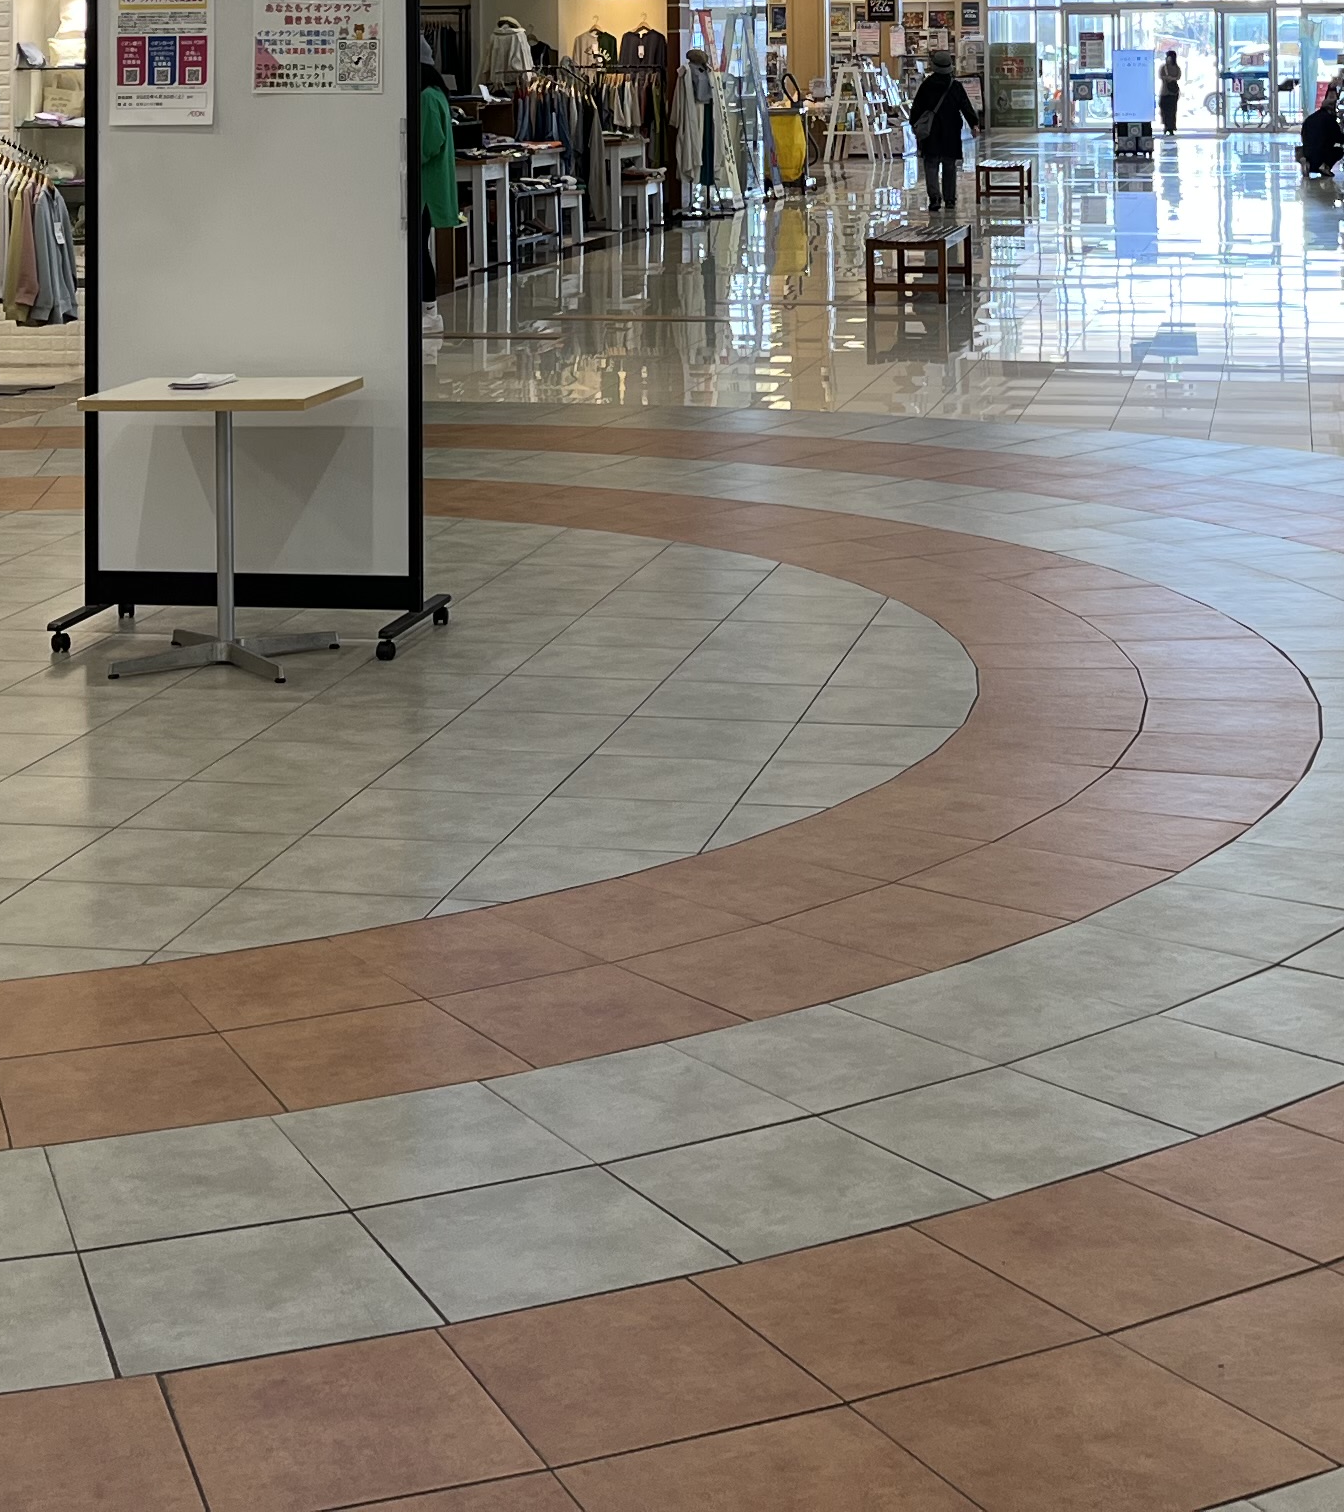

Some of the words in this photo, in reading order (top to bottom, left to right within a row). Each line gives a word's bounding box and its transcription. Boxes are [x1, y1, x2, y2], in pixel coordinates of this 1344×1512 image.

[265, 3, 372, 13] あなたもイオンタウンで
